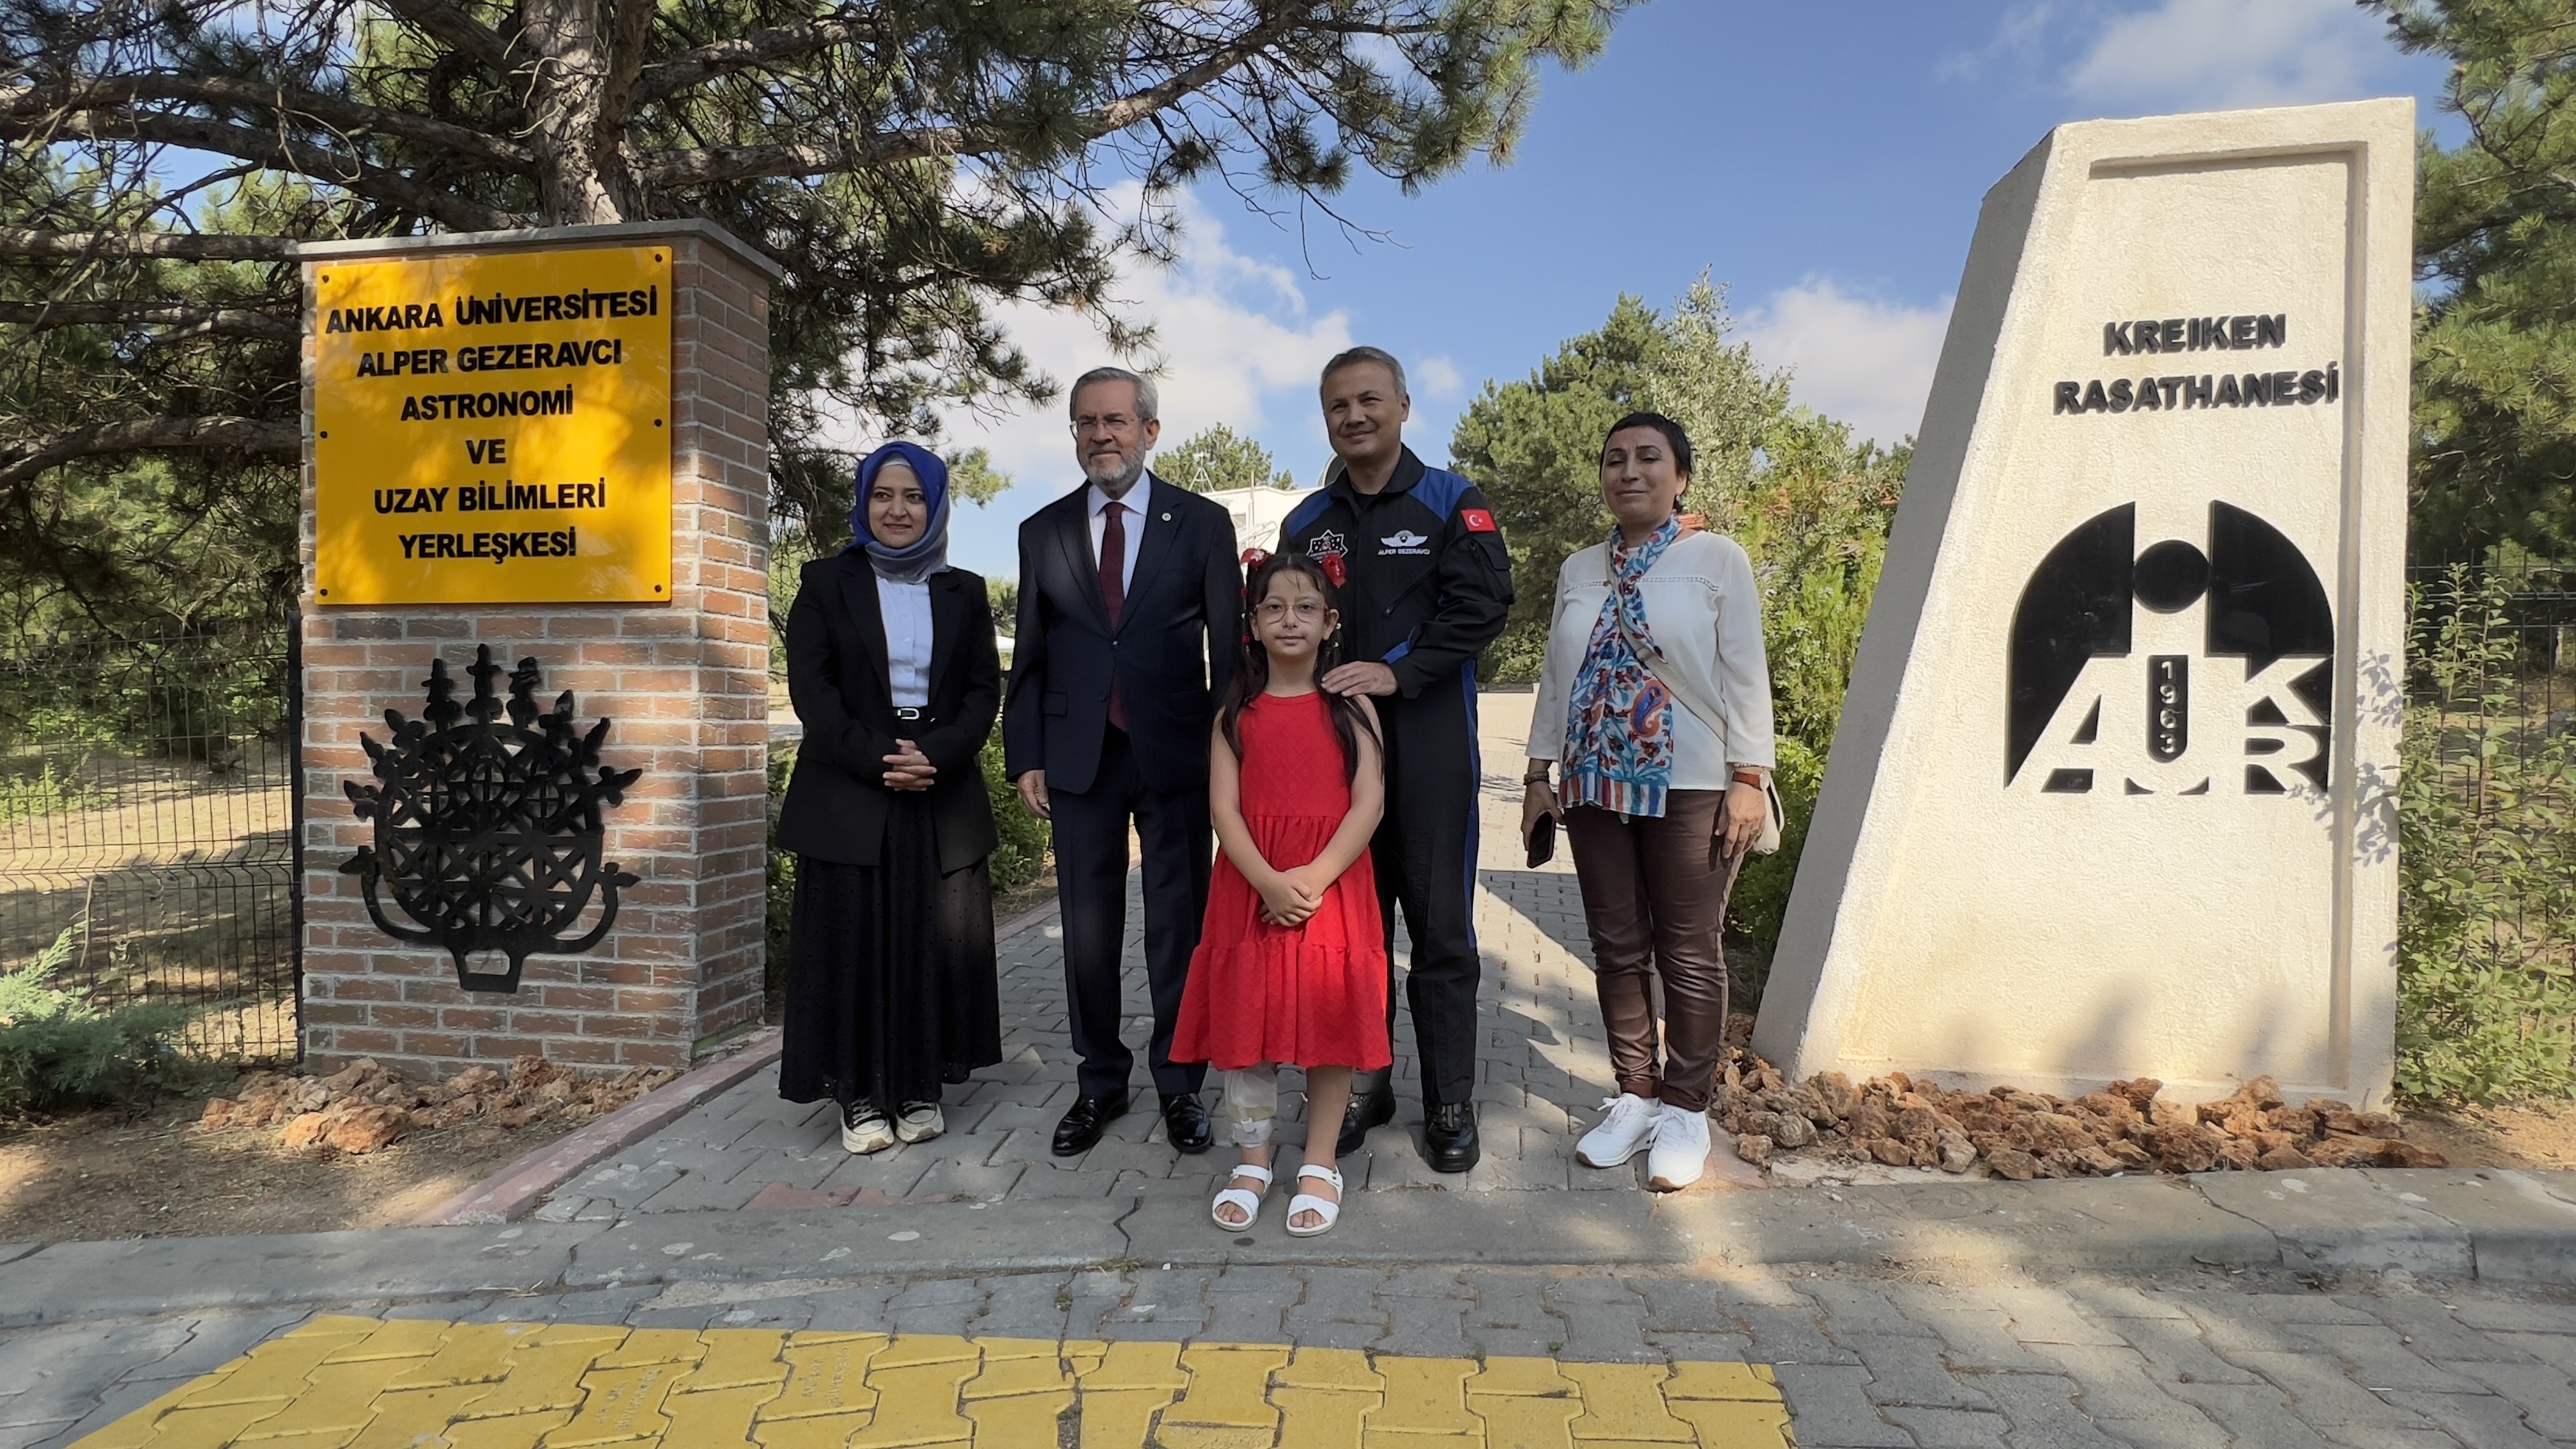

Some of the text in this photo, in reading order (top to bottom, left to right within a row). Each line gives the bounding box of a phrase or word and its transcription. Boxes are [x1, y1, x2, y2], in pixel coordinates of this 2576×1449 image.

[326, 284, 657, 334] ANKARA ÜNİVERSİTESİ
[2104, 314, 2286, 355] KREIKEN
[356, 339, 622, 378] ALPER GEZERAVCI
[400, 383, 574, 422] ASTRONOMİ
[2054, 362, 2339, 415] RASATHANESİ
[466, 438, 507, 465] VE
[374, 477, 606, 514] UZAY BİLİMLERİ
[398, 526, 576, 565] YERLEŞKESİ
[2159, 661, 2179, 754] 1963
